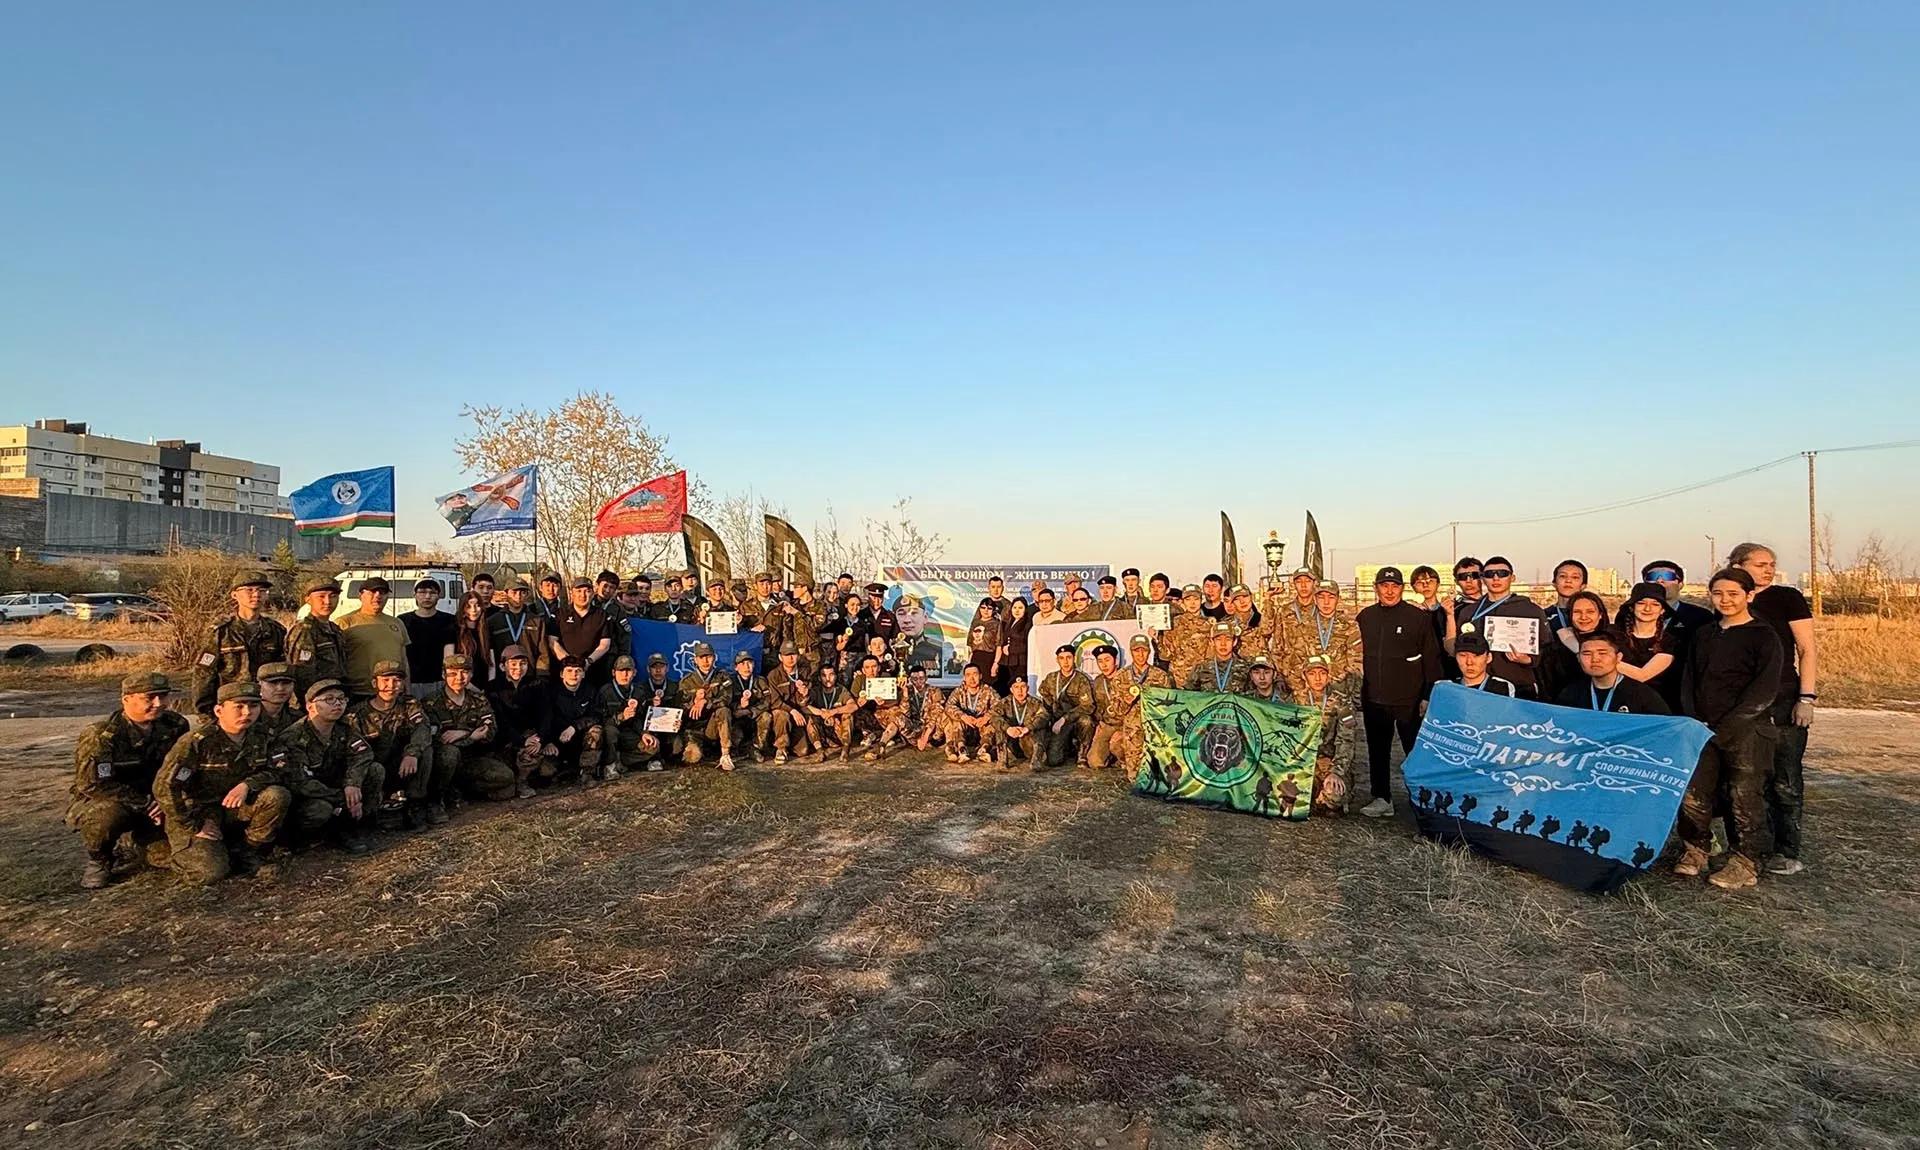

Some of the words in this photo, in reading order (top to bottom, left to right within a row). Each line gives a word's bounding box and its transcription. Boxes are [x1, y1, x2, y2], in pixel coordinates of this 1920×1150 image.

[920, 570, 952, 580] БЫТЬ
[1014, 570, 1048, 580] ЖИТЬ
[1050, 570, 1090, 580] ВЕО
[1594, 761, 1660, 780] СПОРТИВНЫЙ
[1659, 772, 1686, 788] КЛУБ
